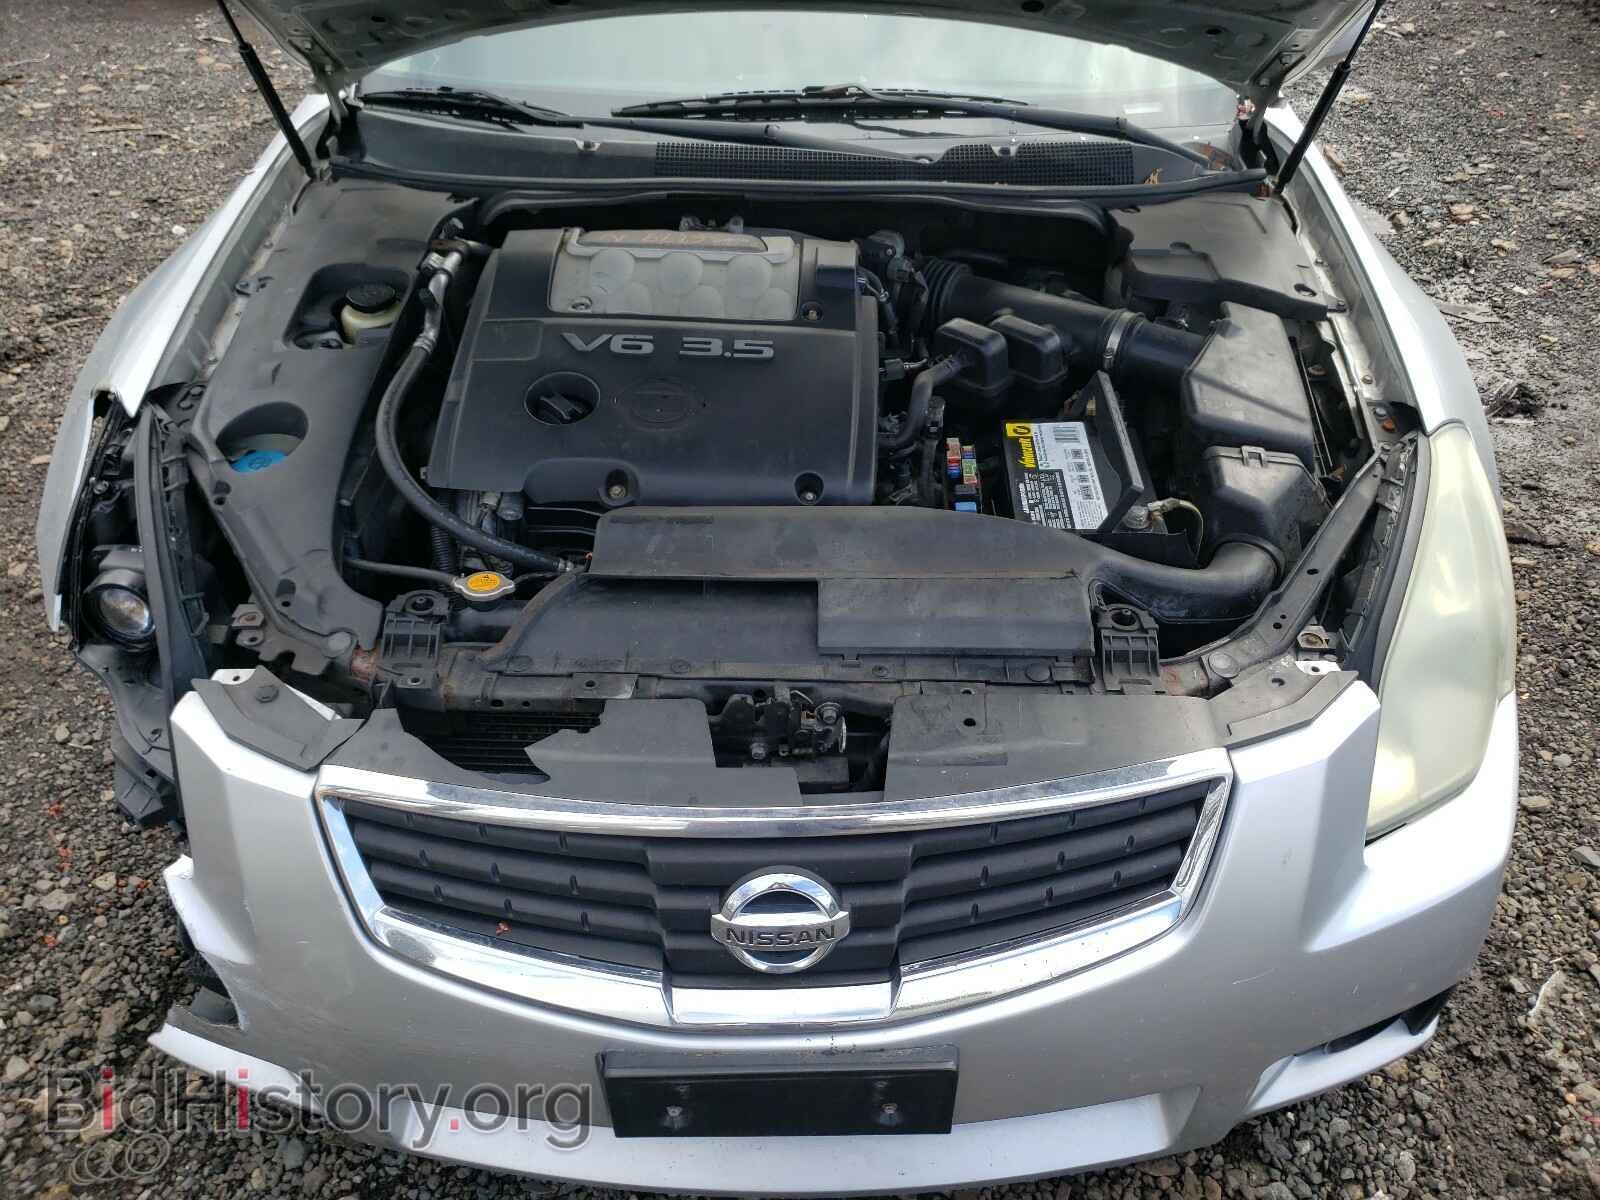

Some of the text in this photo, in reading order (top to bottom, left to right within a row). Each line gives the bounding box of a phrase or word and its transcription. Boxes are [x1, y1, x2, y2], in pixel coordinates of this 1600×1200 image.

[561, 332, 775, 359] V6 3.5
[725, 924, 836, 946] NISSAN
